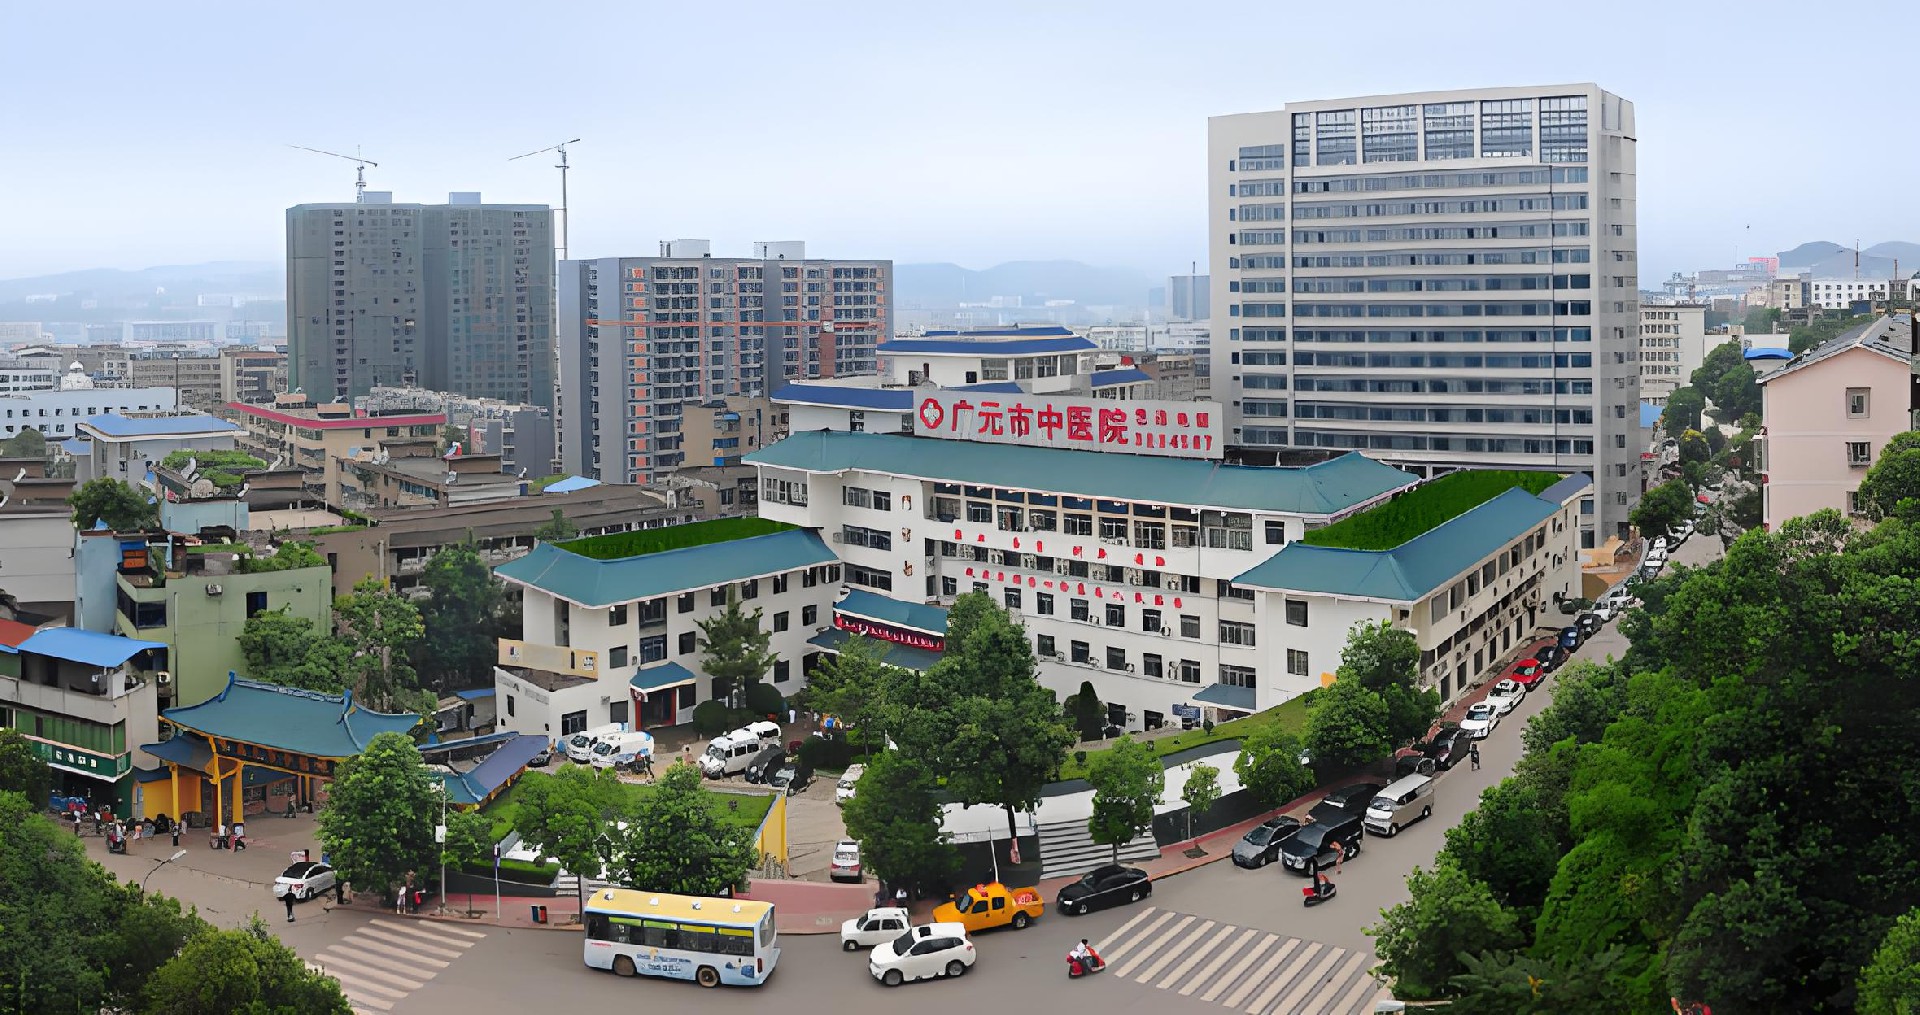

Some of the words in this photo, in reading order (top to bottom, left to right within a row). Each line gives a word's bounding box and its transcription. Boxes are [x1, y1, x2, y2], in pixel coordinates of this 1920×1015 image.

[952, 400, 1128, 444] 广元市中医院
